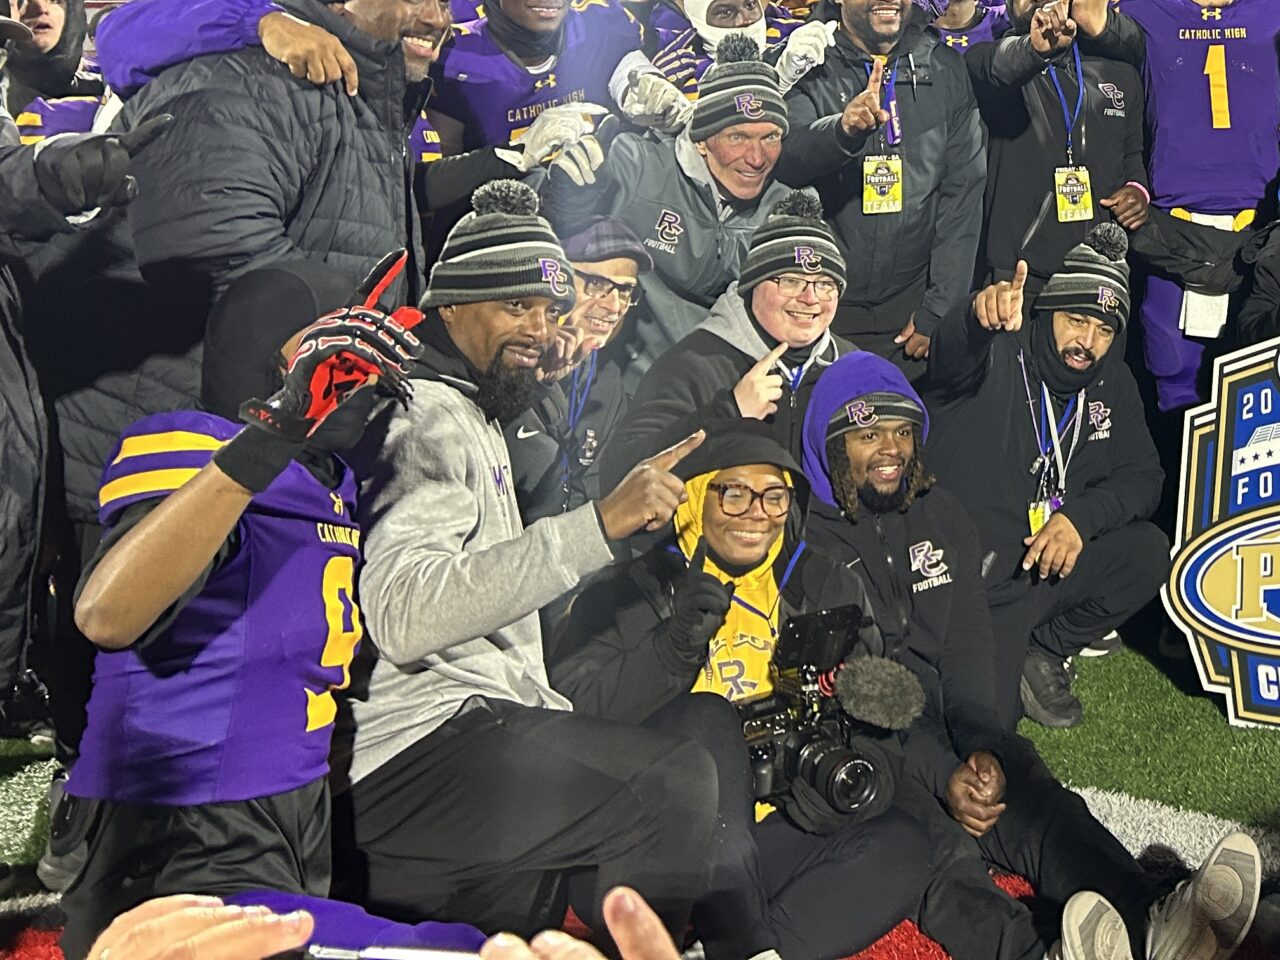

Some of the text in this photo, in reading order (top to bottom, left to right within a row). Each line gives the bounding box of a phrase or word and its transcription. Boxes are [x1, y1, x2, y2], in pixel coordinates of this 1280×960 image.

[1179, 28, 1247, 39] CATHOLIC HIGH
[1098, 83, 1124, 109] RC
[1204, 45, 1231, 128] 1
[734, 93, 765, 119] RC
[1103, 108, 1126, 117] FOOTBALL
[867, 175, 898, 183] FOOTBALL
[865, 200, 899, 212] TEAM
[1060, 208, 1092, 220] TEAM
[655, 209, 684, 243] RC
[643, 238, 675, 254] FOOTBALL
[794, 246, 821, 273] RC
[538, 258, 568, 296] RC
[1097, 285, 1119, 315] RC
[846, 400, 879, 427] RC
[1242, 387, 1272, 420] 20
[909, 541, 949, 578] RC
[913, 573, 952, 594] FOOTBALL
